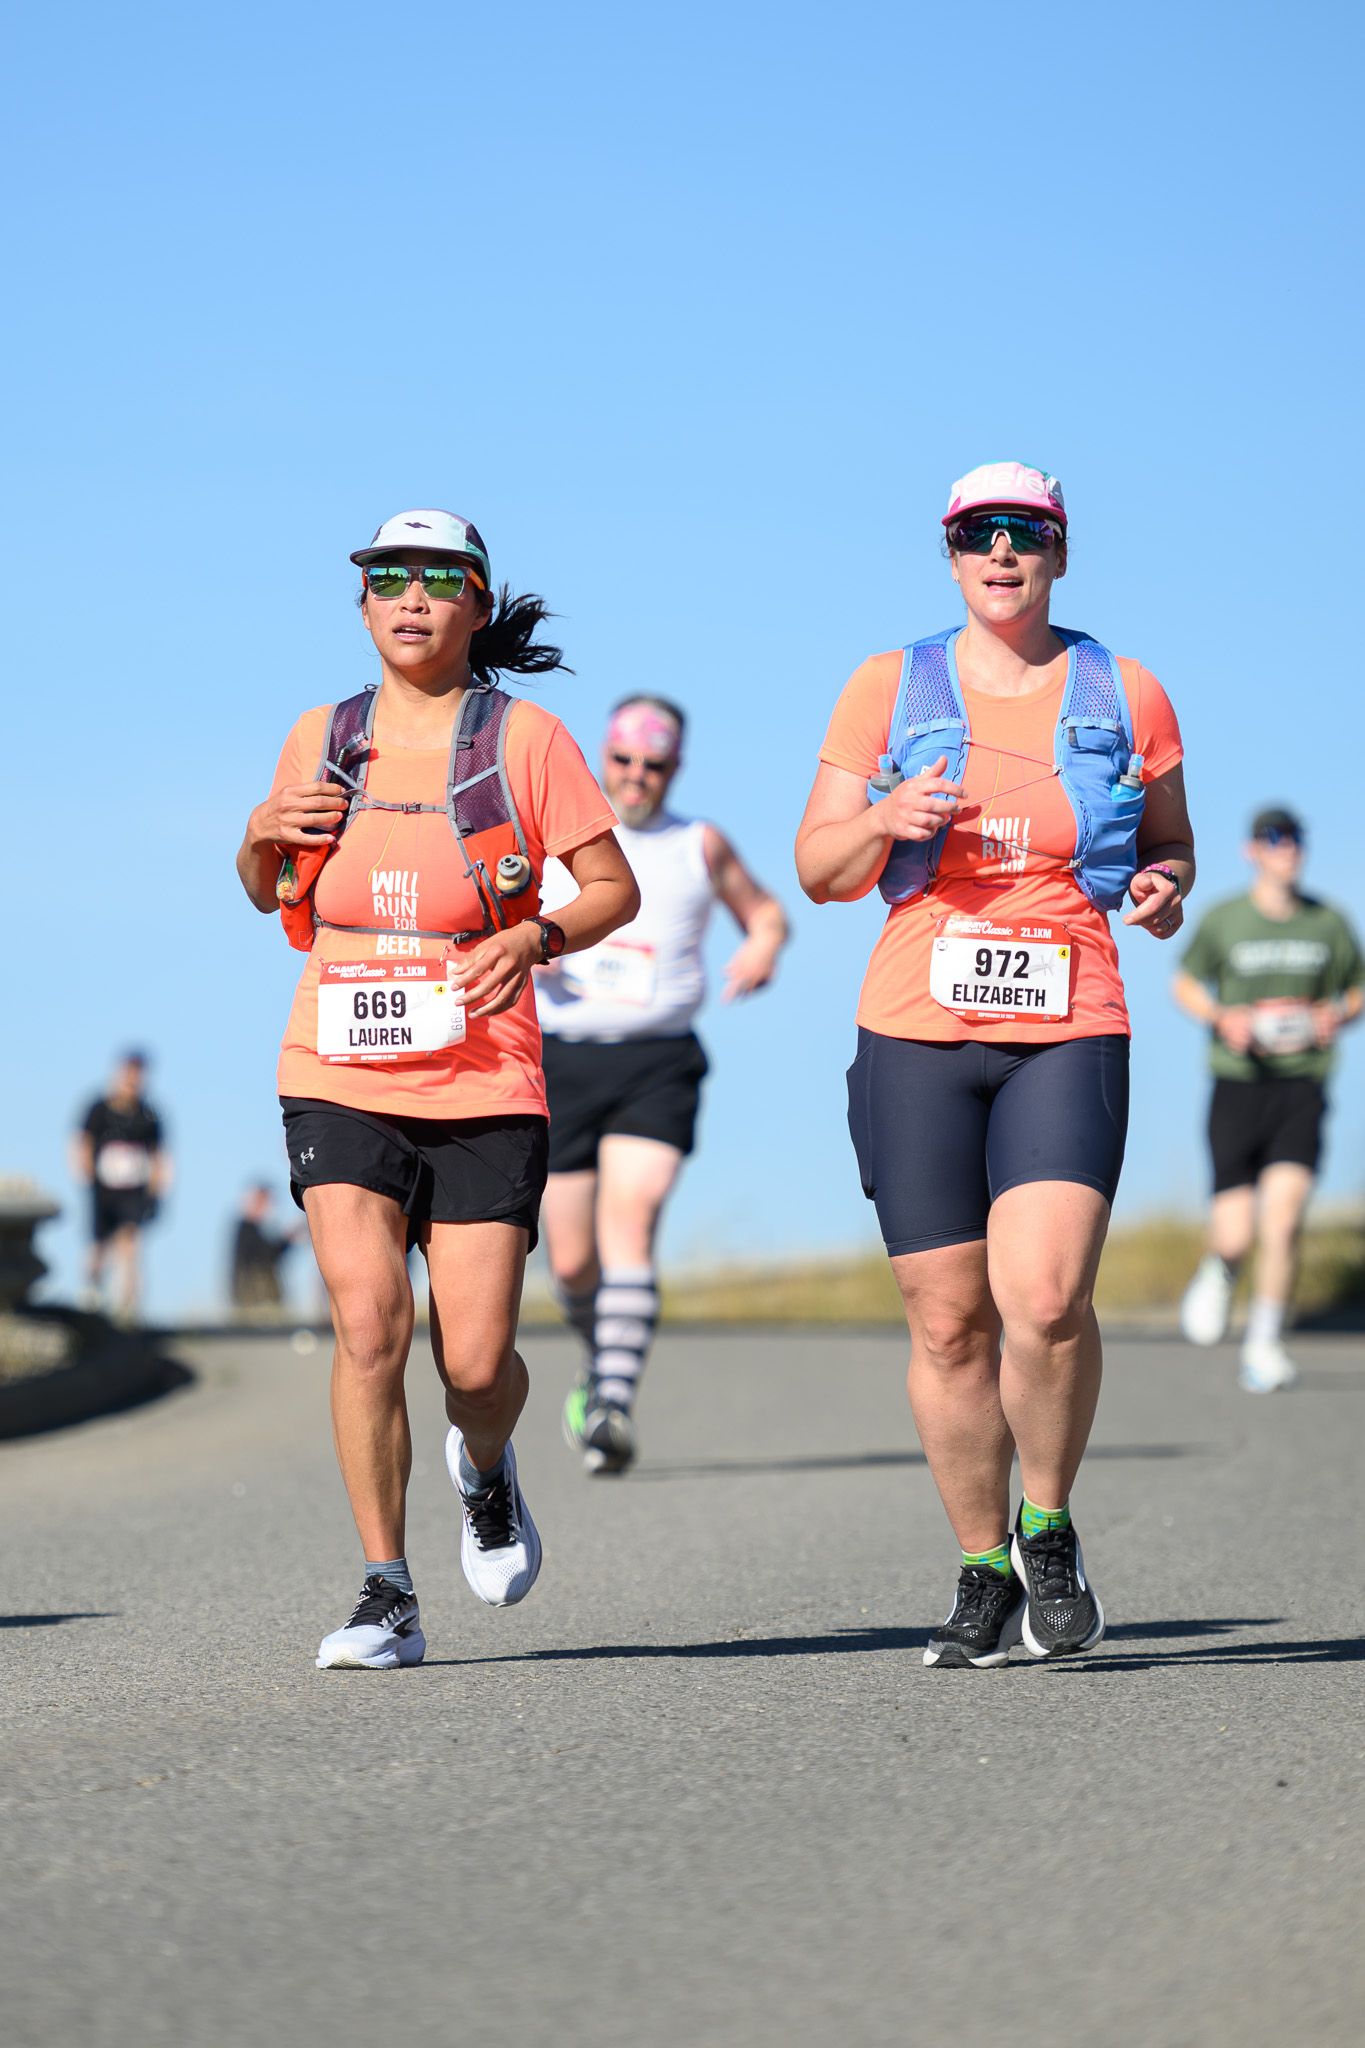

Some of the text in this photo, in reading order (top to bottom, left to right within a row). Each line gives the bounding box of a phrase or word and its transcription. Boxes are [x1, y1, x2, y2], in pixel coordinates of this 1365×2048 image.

[981, 817, 1031, 842] WILL
[982, 840, 1028, 861] RUN
[372, 870, 419, 898] WILL
[373, 894, 417, 919] RUN
[393, 917, 418, 931] FOR
[1020, 927, 1052, 939] 21.1KM
[376, 934, 421, 957] BEER
[393, 966, 427, 977] 21.1KM
[975, 948, 1030, 979] 972
[353, 990, 407, 1020] 669
[952, 983, 1046, 1007] ELIZABETH
[349, 1027, 412, 1047] LAUREN
